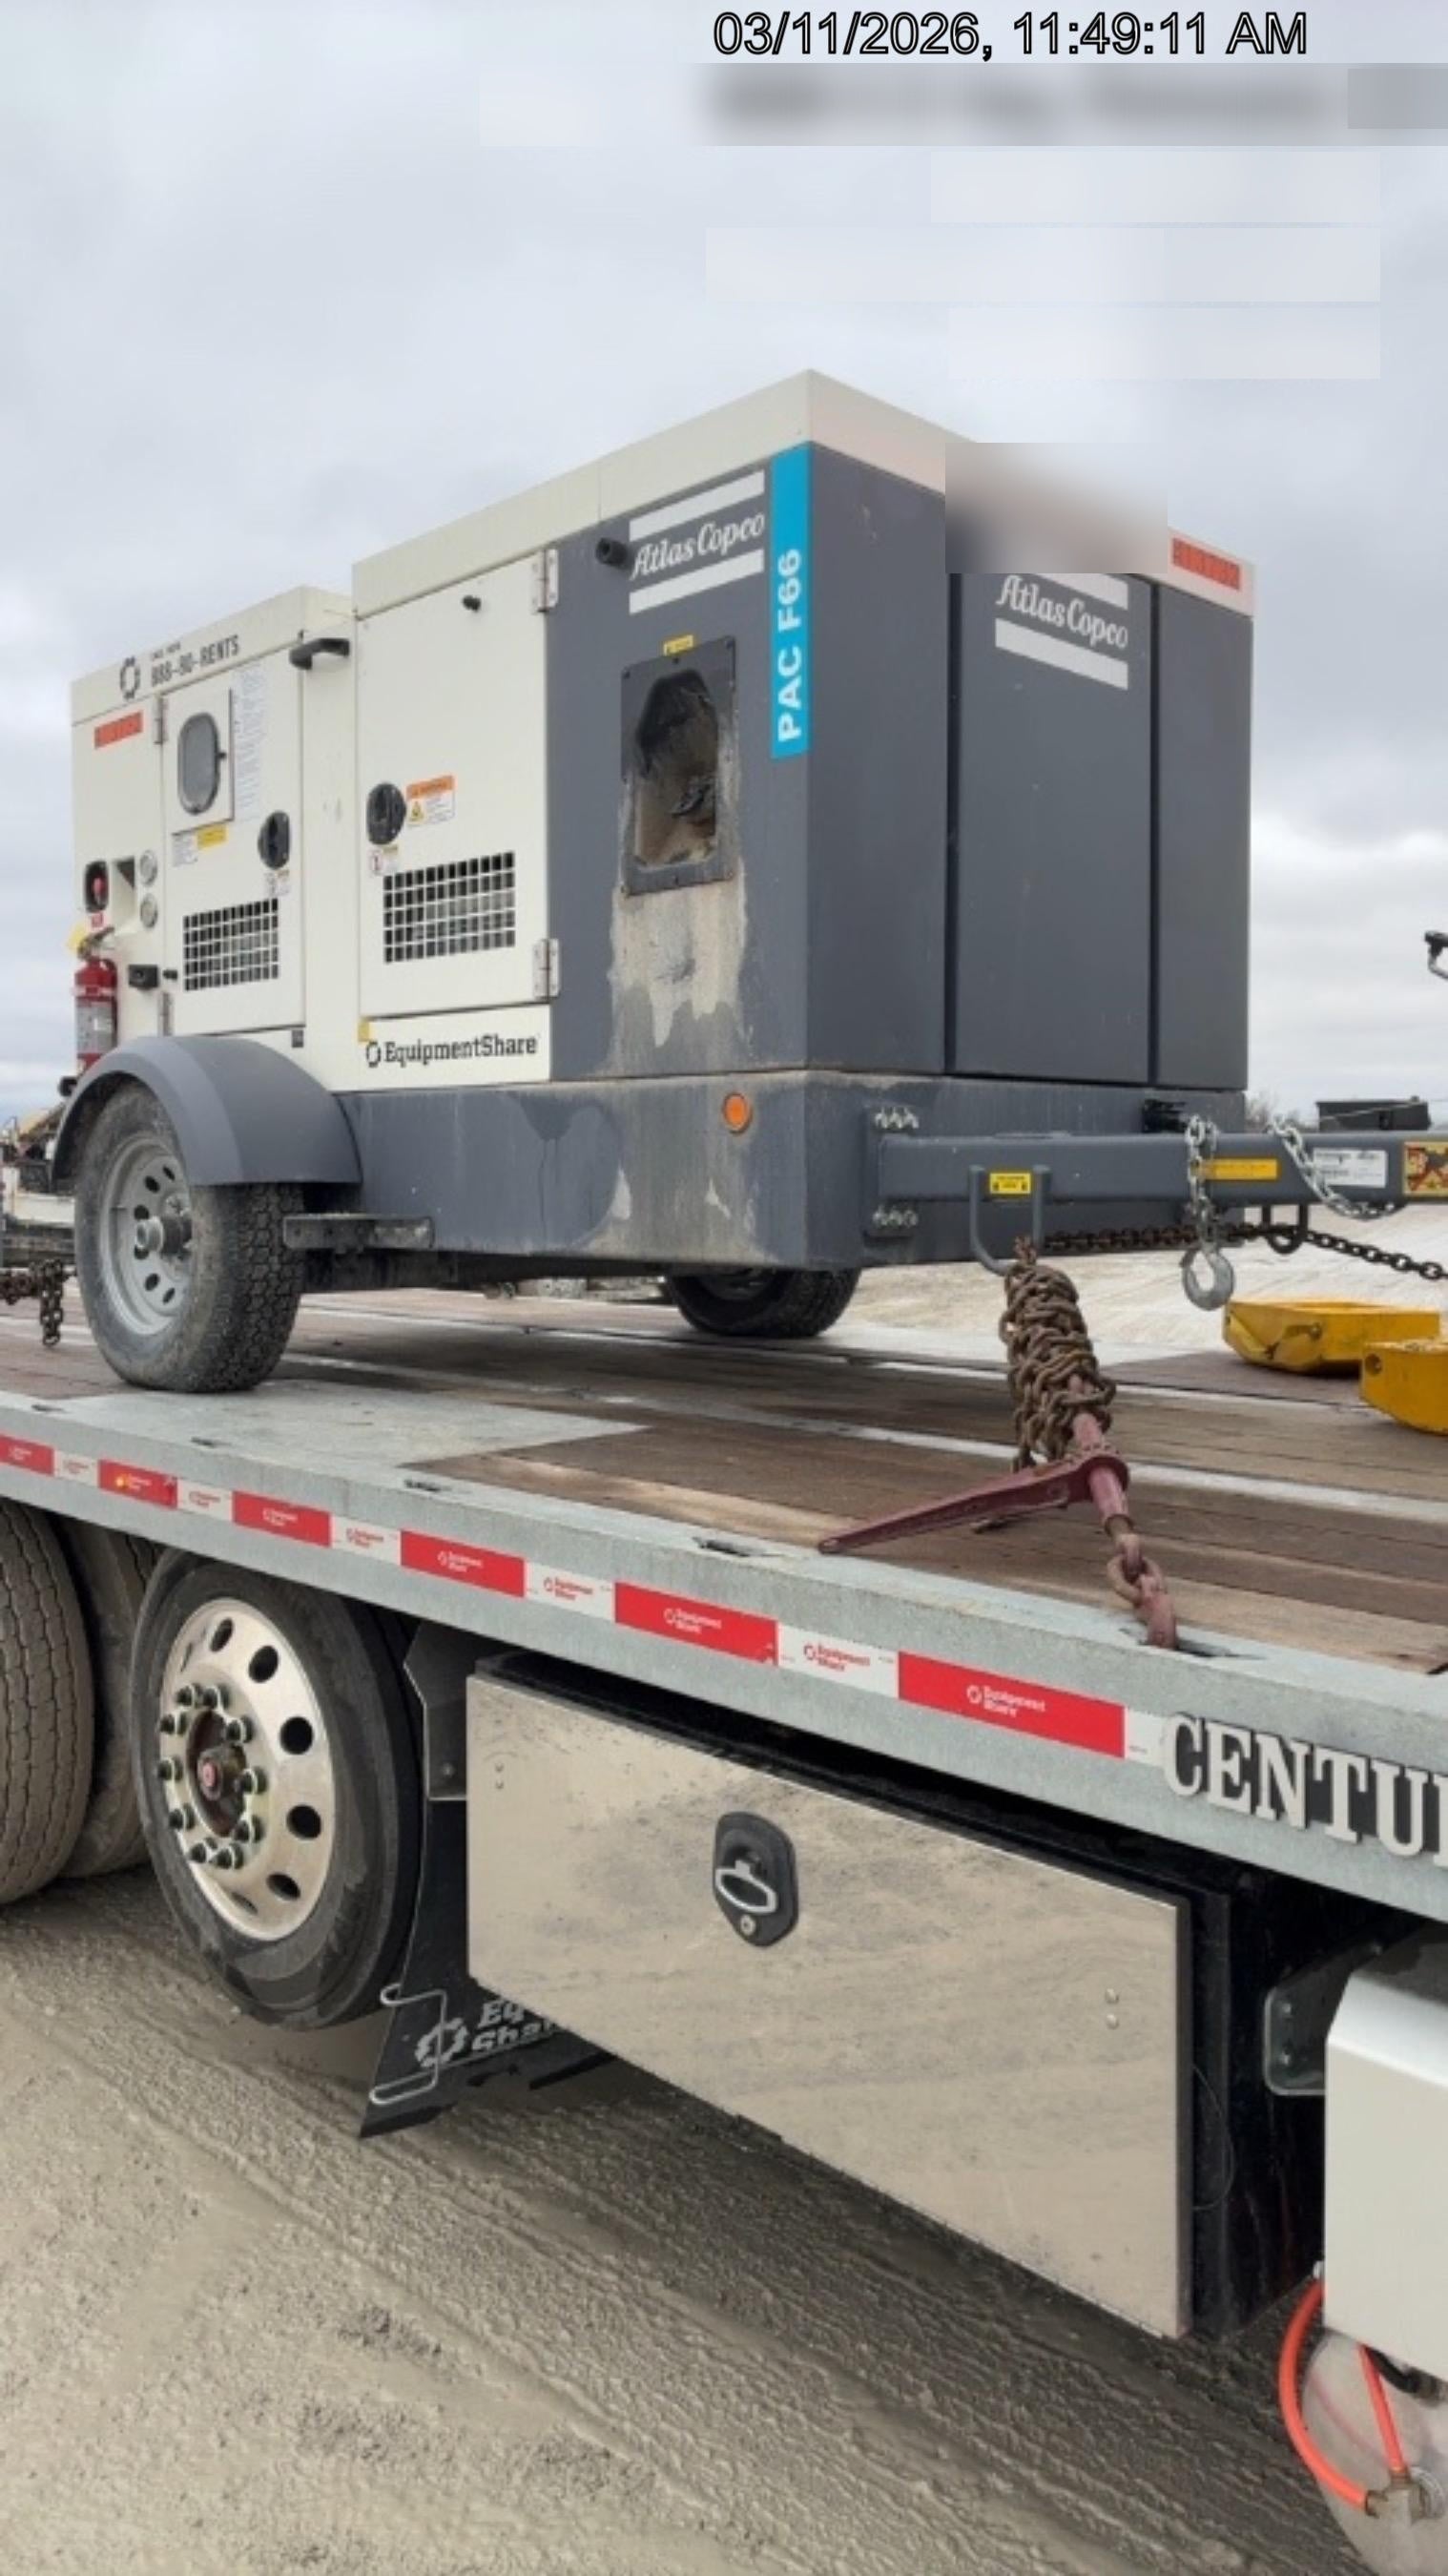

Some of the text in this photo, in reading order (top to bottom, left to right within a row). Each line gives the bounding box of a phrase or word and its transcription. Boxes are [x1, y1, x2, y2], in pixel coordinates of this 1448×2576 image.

[630, 512, 766, 580] Atlas Copco
[777, 549, 802, 742] PAC F66
[995, 574, 1128, 650] Atlas Copco
[383, 1034, 537, 1069] EquipmentShare
